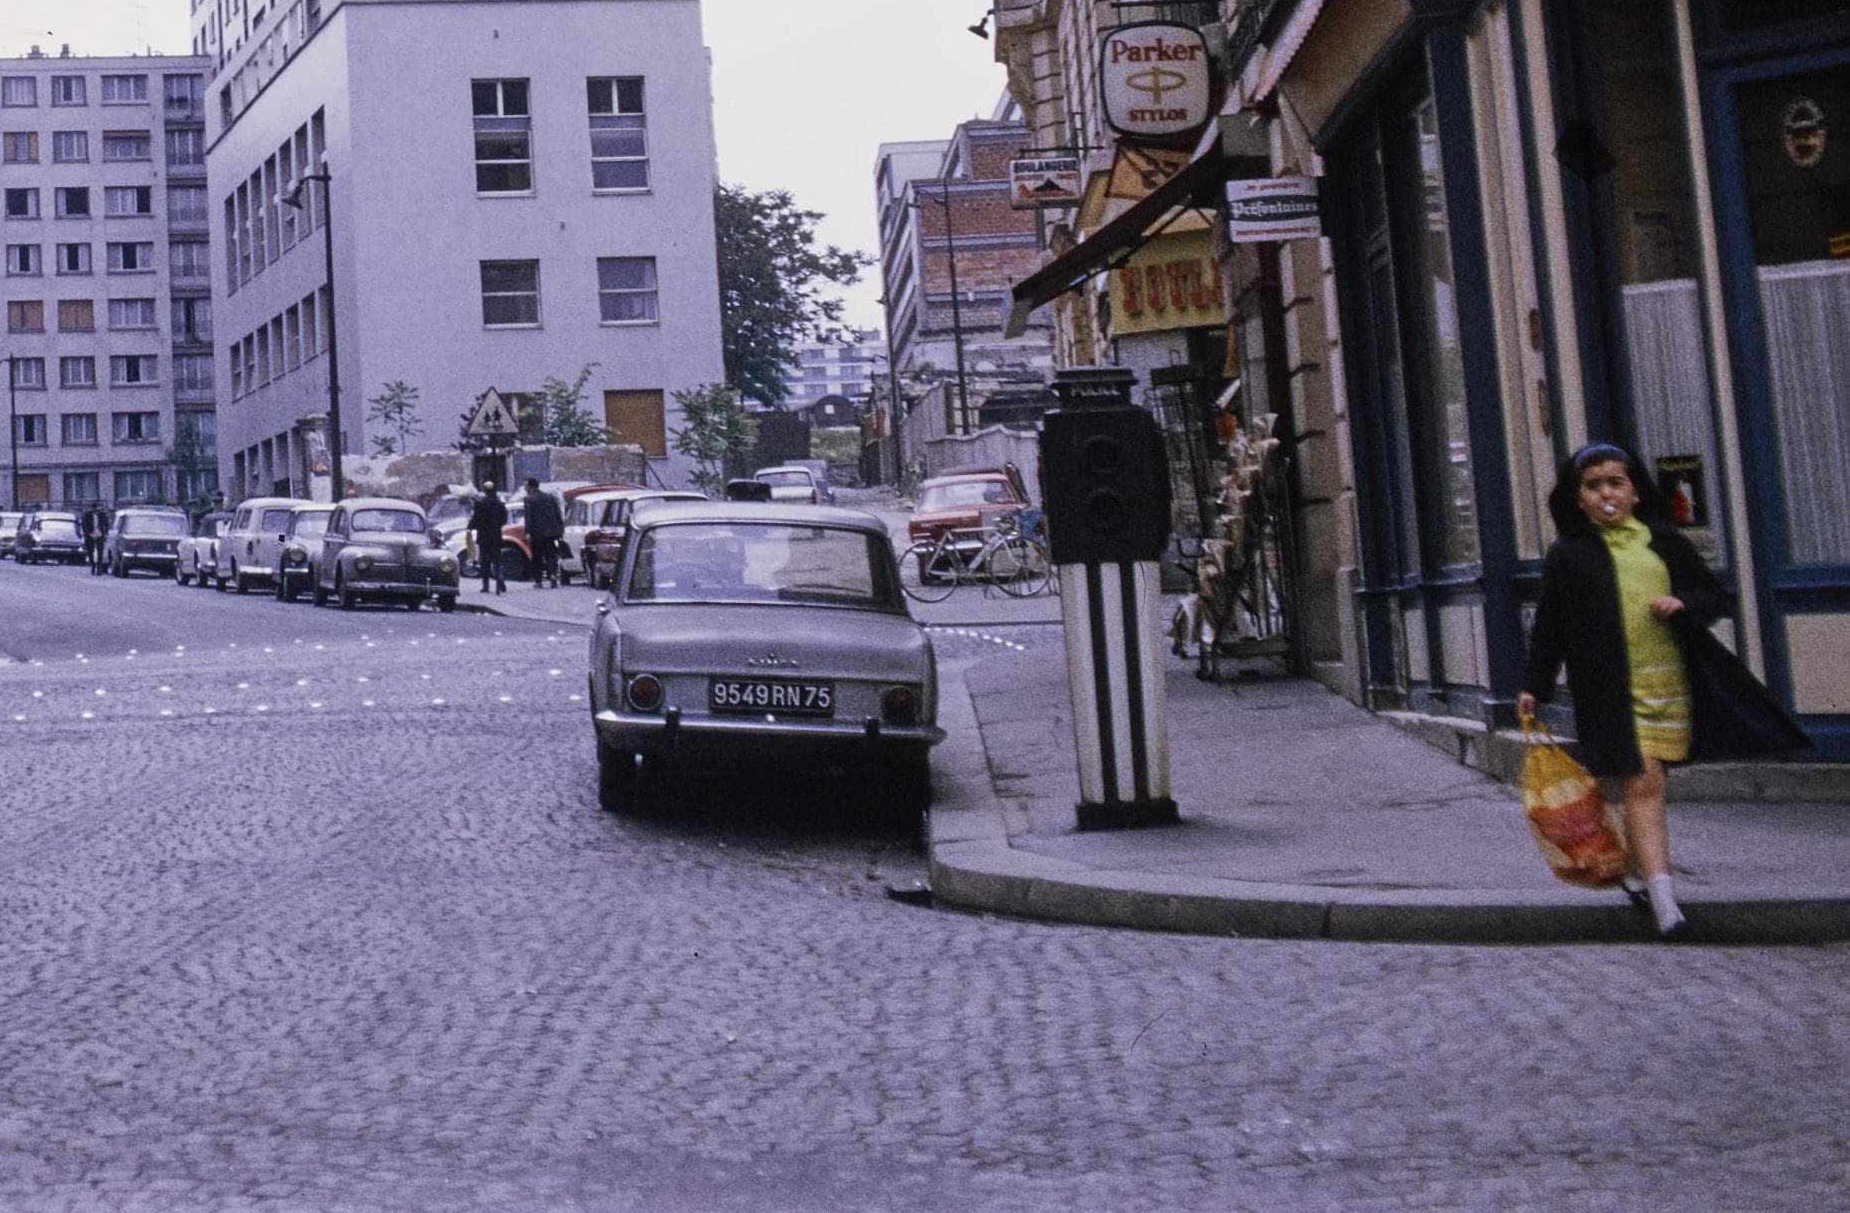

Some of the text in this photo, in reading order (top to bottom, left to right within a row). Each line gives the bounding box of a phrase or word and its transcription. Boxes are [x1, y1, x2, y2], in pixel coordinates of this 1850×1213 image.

[1111, 38, 1202, 64] Parker
[1128, 108, 1187, 122] STYLOS
[714, 683, 831, 708] 9549 RN 75
